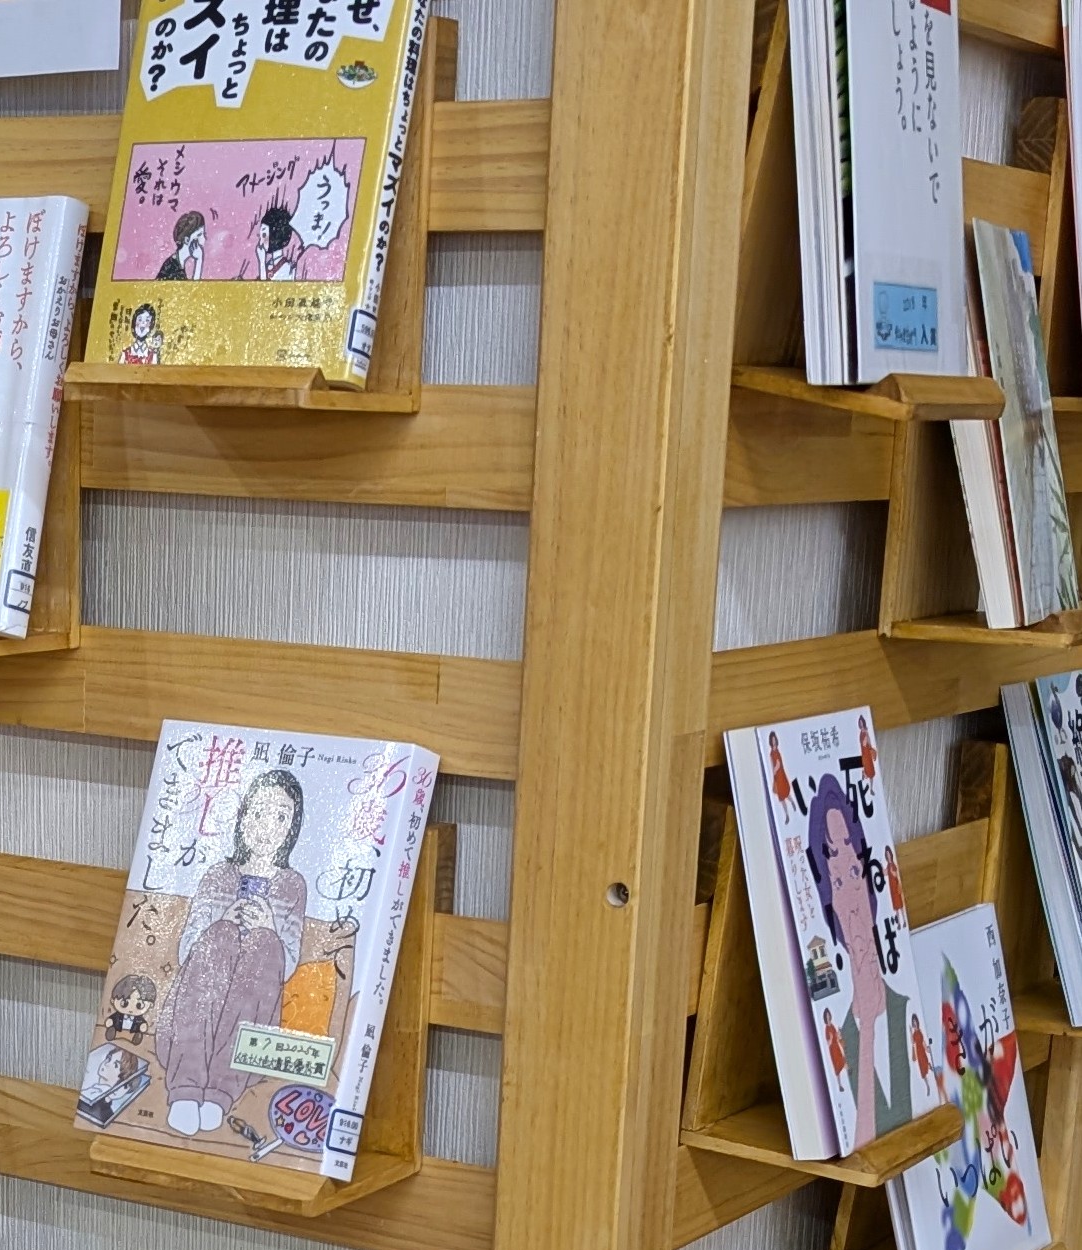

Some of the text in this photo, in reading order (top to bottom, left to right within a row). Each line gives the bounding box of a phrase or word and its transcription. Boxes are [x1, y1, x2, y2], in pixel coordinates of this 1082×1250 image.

[222, 13, 250, 99] ちょっと
[304, 0, 337, 62] たの
[924, 11, 940, 204] を見ないで
[151, 158, 169, 206] それは
[168, 145, 186, 213] メシウマ
[10, 210, 47, 371] ぼけますから、
[44, 275, 67, 361] おかえりお母さん
[252, 741, 271, 763] 凪
[839, 756, 901, 976] 死ねば
